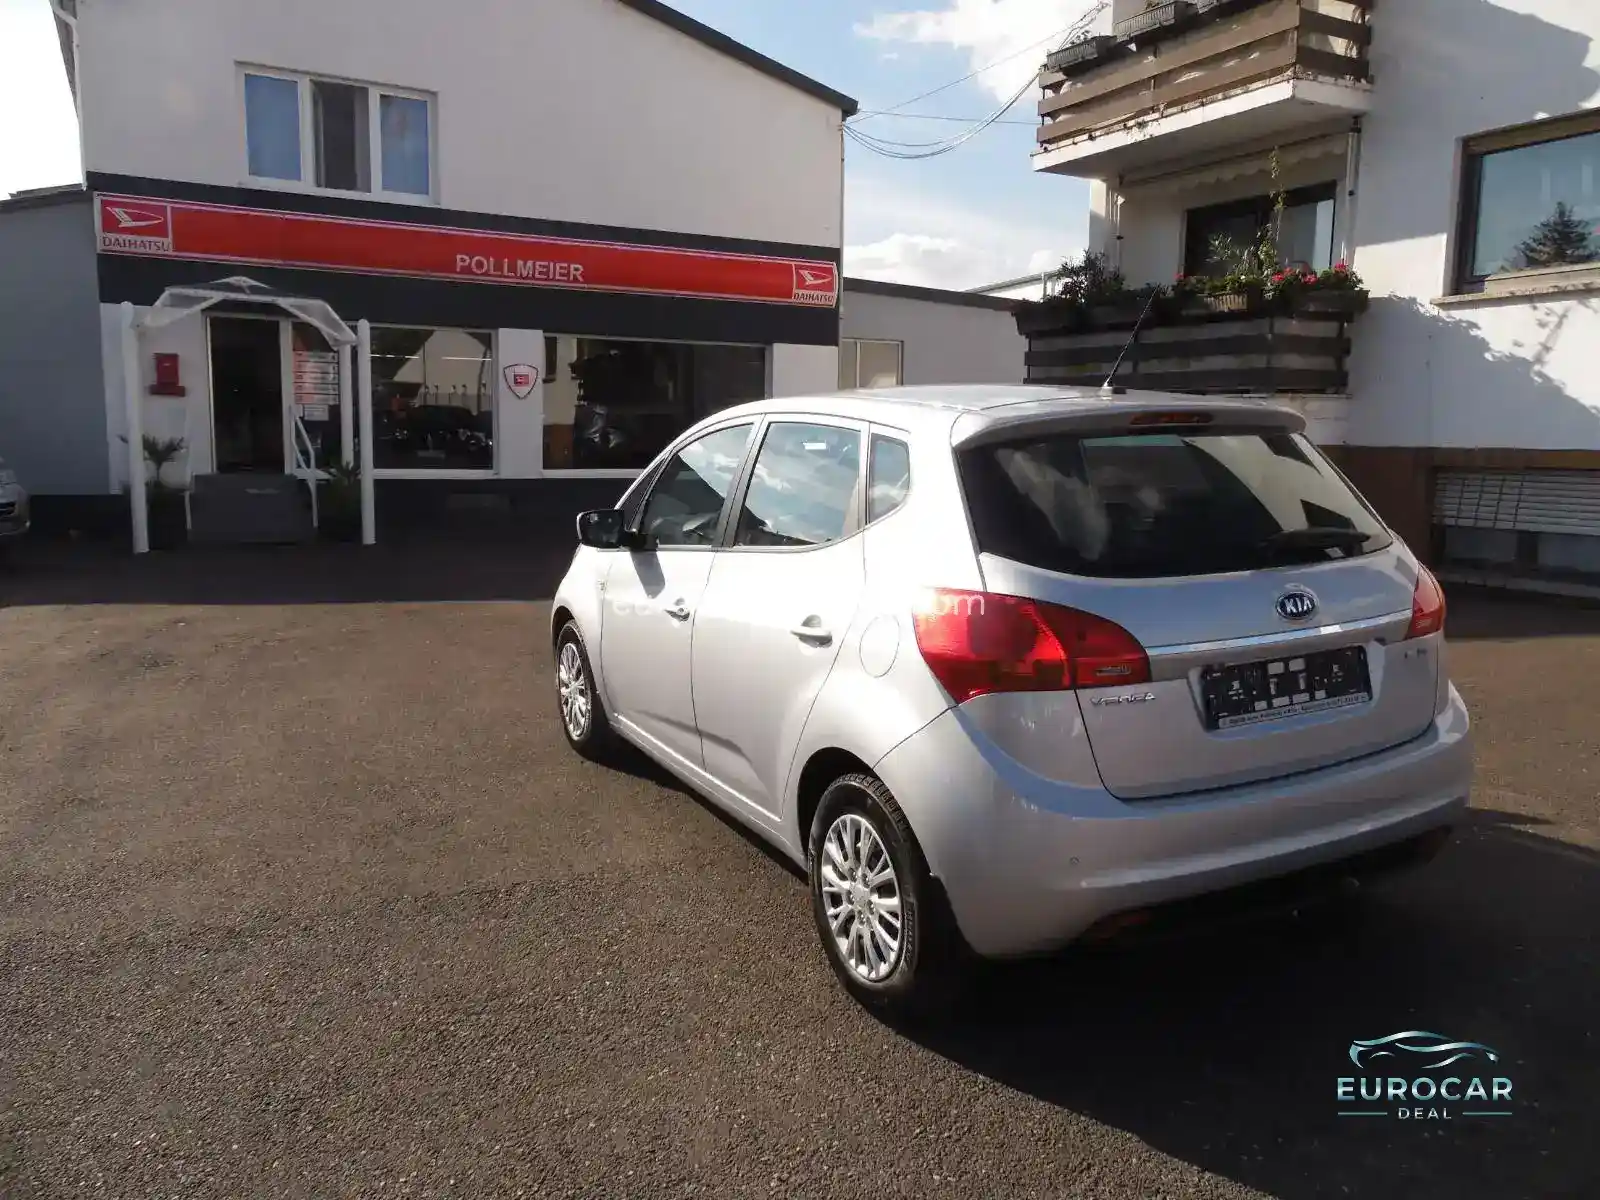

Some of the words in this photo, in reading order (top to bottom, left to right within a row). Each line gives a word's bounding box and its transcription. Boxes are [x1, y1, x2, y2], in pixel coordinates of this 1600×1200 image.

[101, 236, 172, 252] DAIHATSU
[455, 253, 584, 282] POLLMEIER
[793, 291, 834, 304] DAIHATSU
[1284, 596, 1313, 614] KIA
